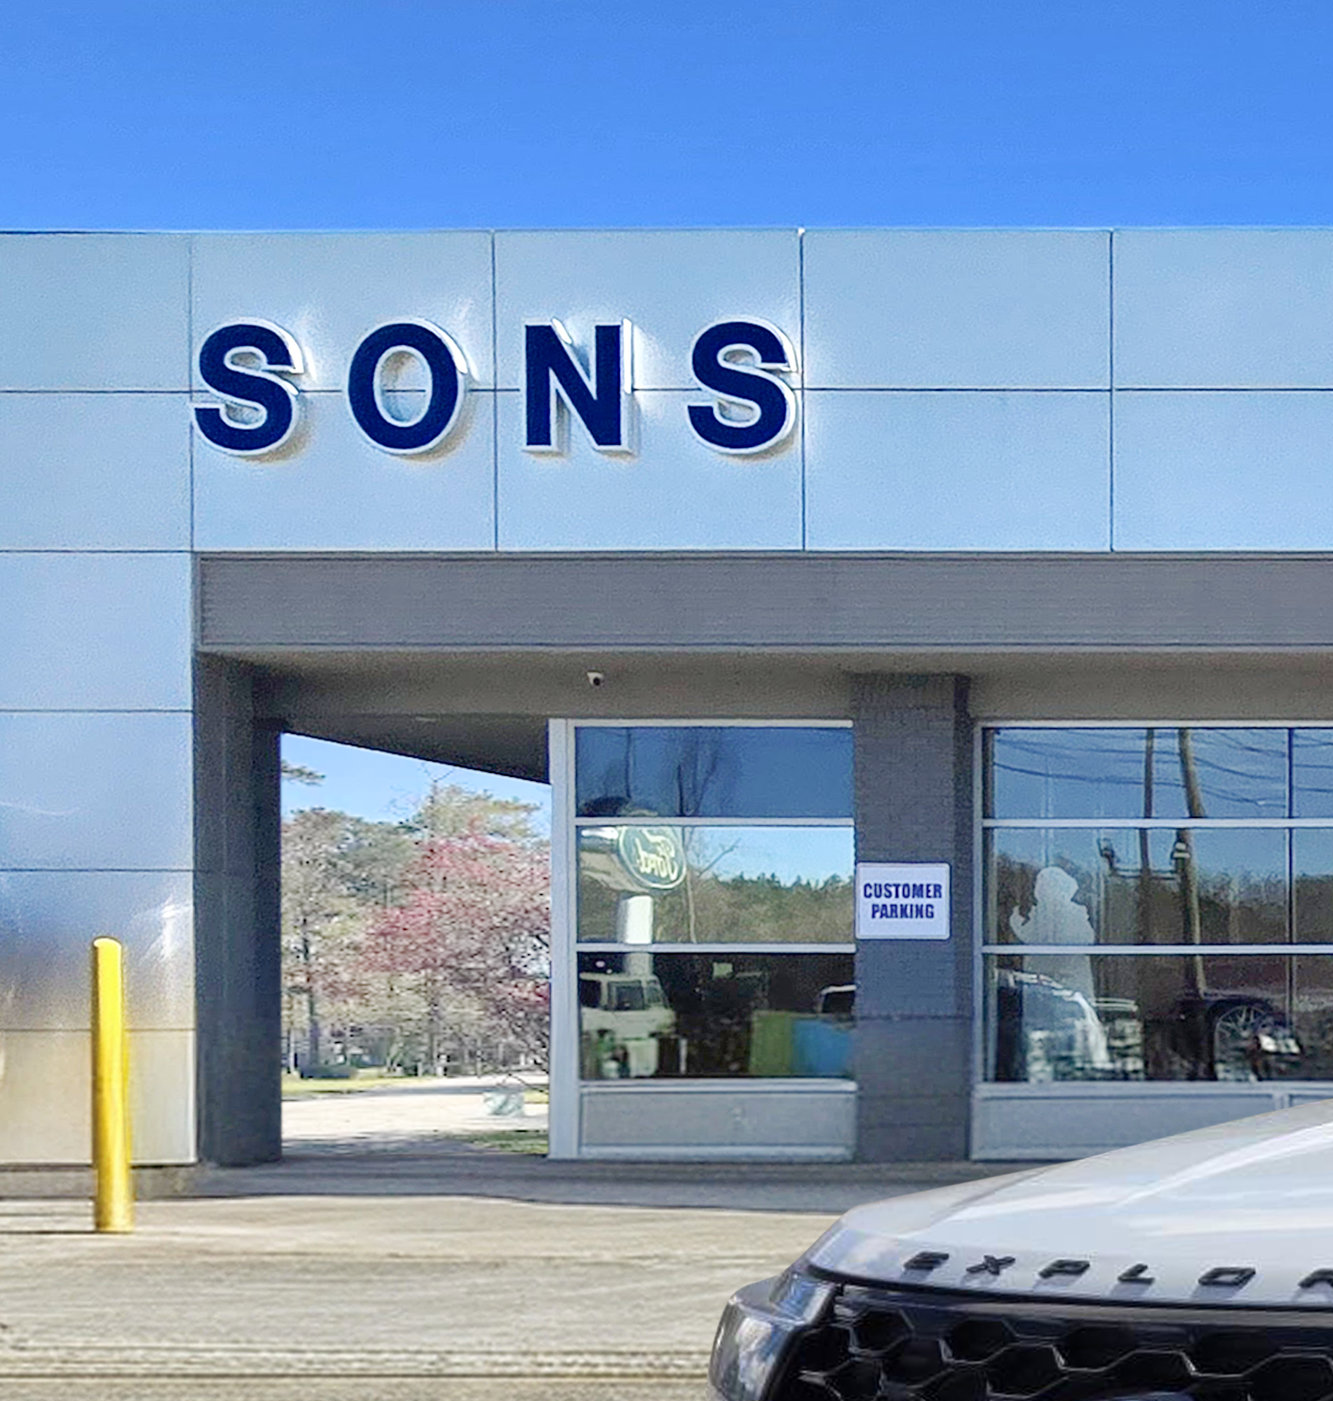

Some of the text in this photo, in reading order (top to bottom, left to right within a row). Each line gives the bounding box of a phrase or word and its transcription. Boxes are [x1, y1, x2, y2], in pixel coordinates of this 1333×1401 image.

[194, 322, 794, 452] SONS
[863, 882, 943, 899] CUSTOMER
[871, 903, 935, 919] PARKING
